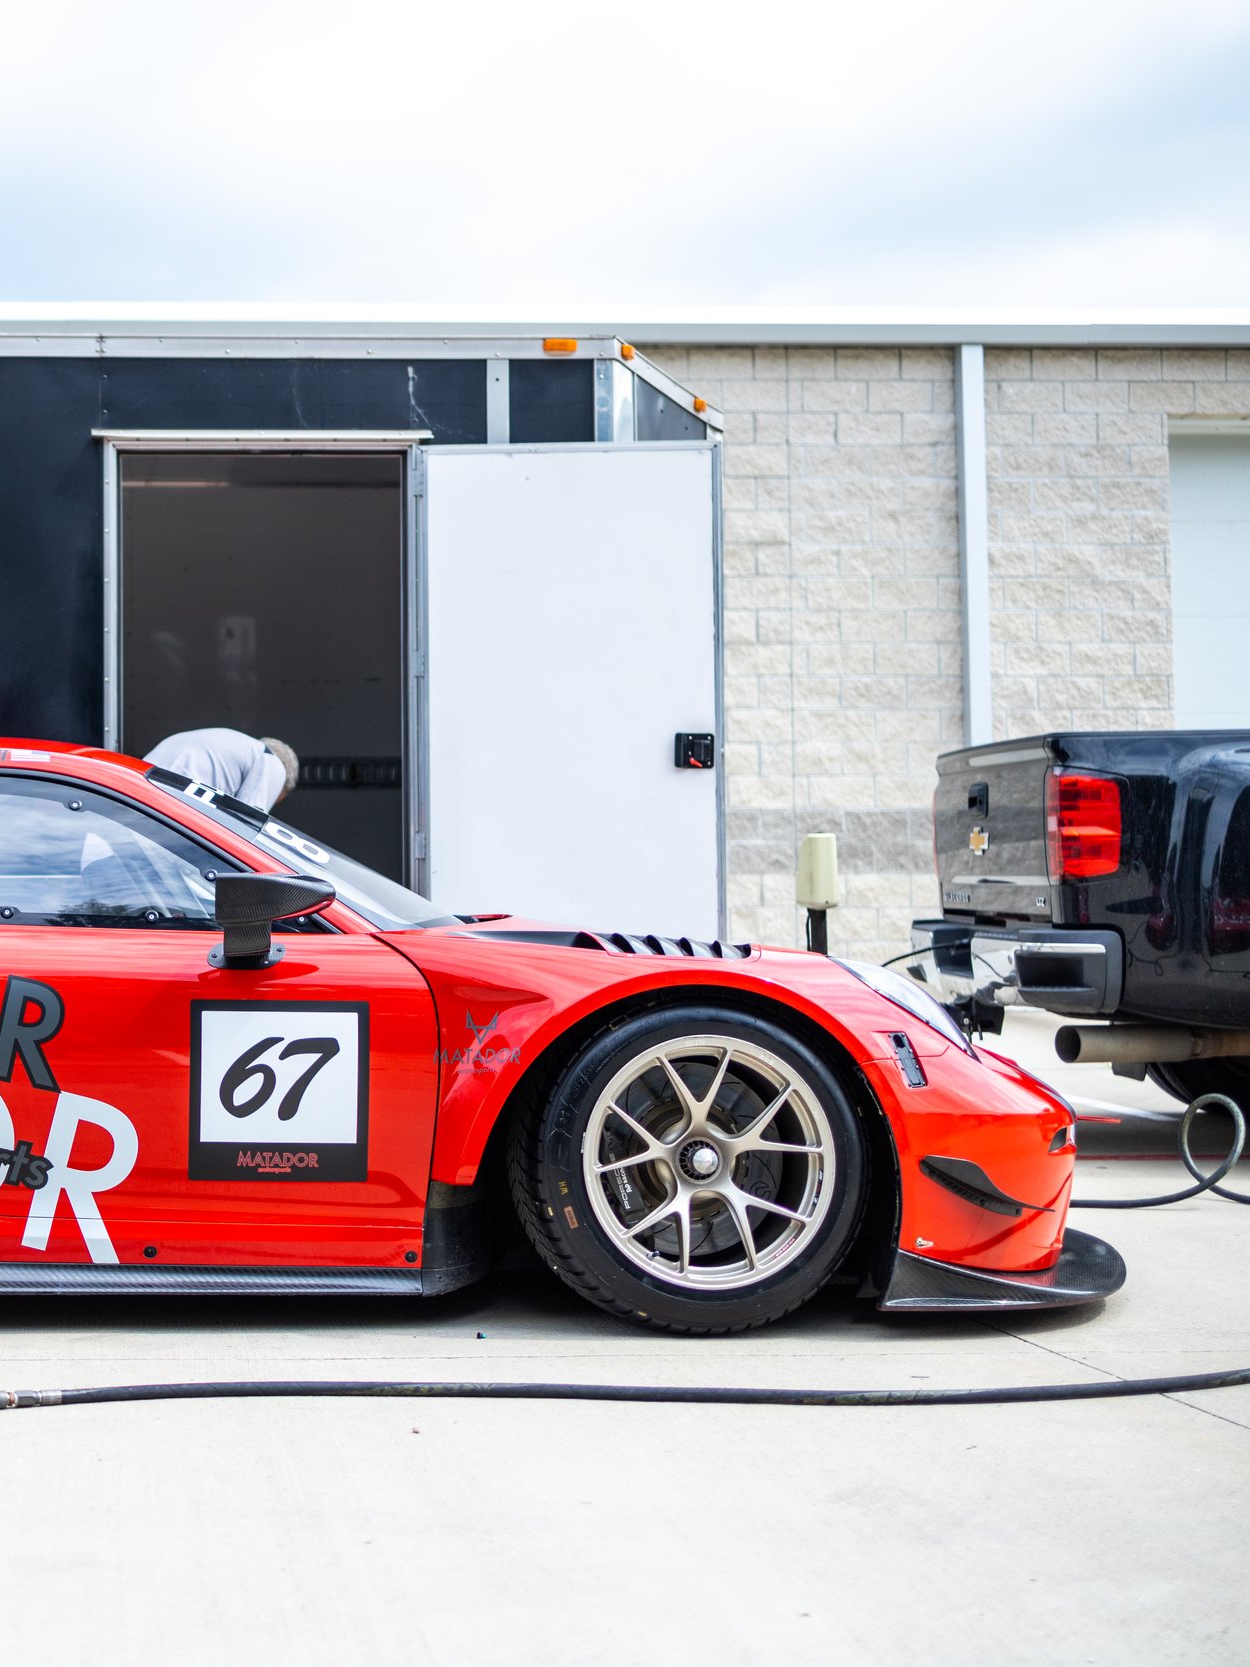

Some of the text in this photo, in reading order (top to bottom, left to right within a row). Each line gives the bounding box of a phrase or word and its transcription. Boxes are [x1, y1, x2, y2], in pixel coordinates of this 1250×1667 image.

[433, 1047, 522, 1065] MATADOR
[219, 1036, 340, 1121] 67
[236, 1150, 319, 1168] MATADOR
